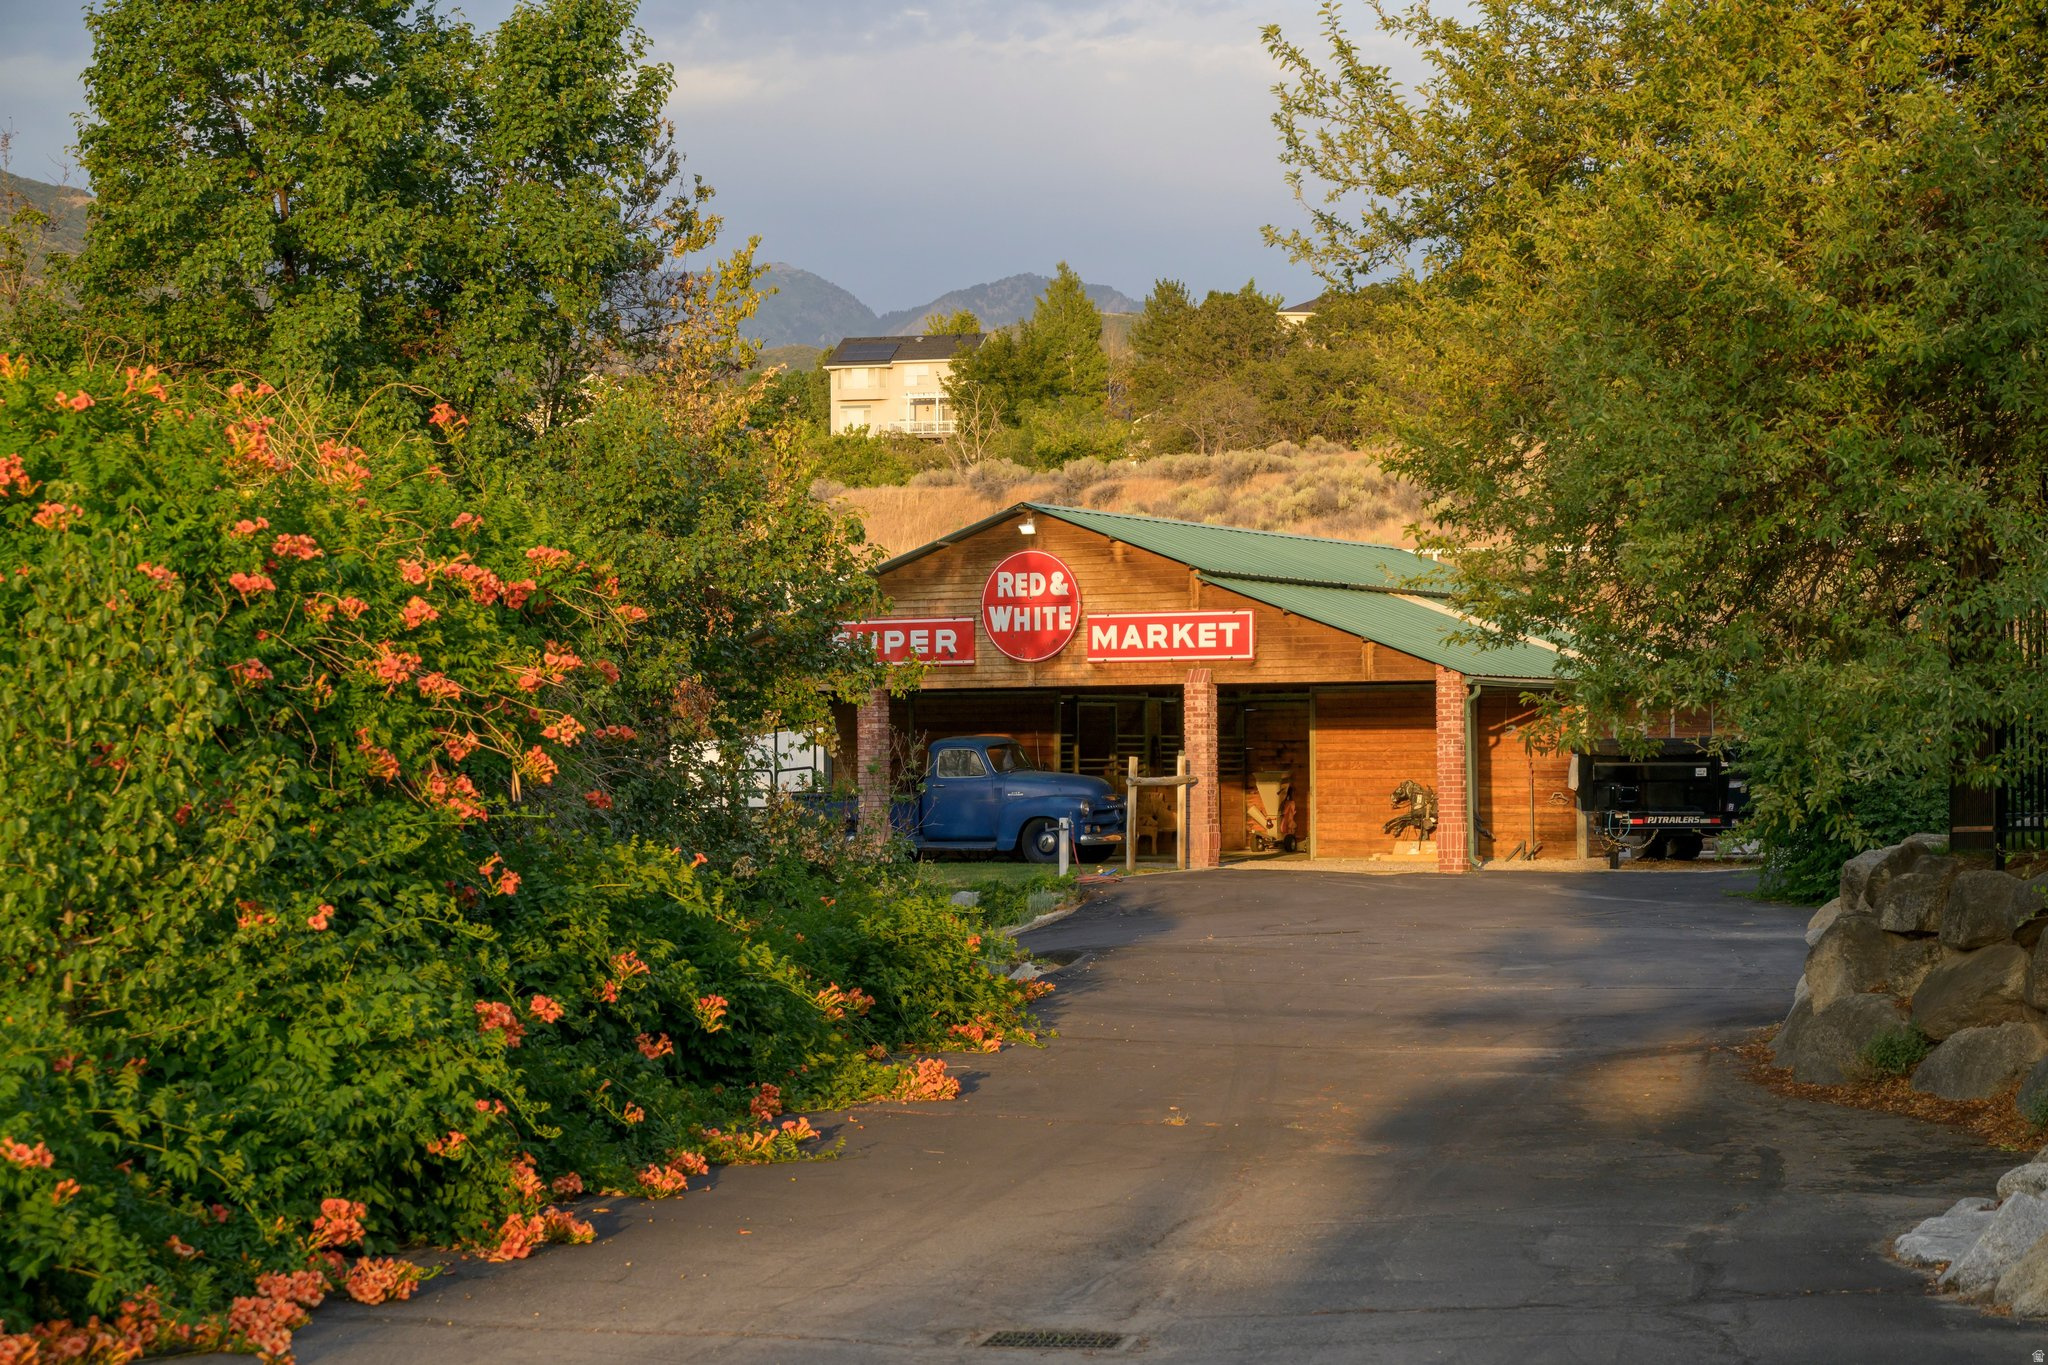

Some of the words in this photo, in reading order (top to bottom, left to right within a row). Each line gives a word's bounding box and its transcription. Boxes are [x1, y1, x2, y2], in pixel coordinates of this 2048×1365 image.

[998, 571, 1046, 597] RED
[1049, 571, 1069, 596] &
[988, 606, 1071, 632] WHITE
[1092, 622, 1240, 650] MARKET
